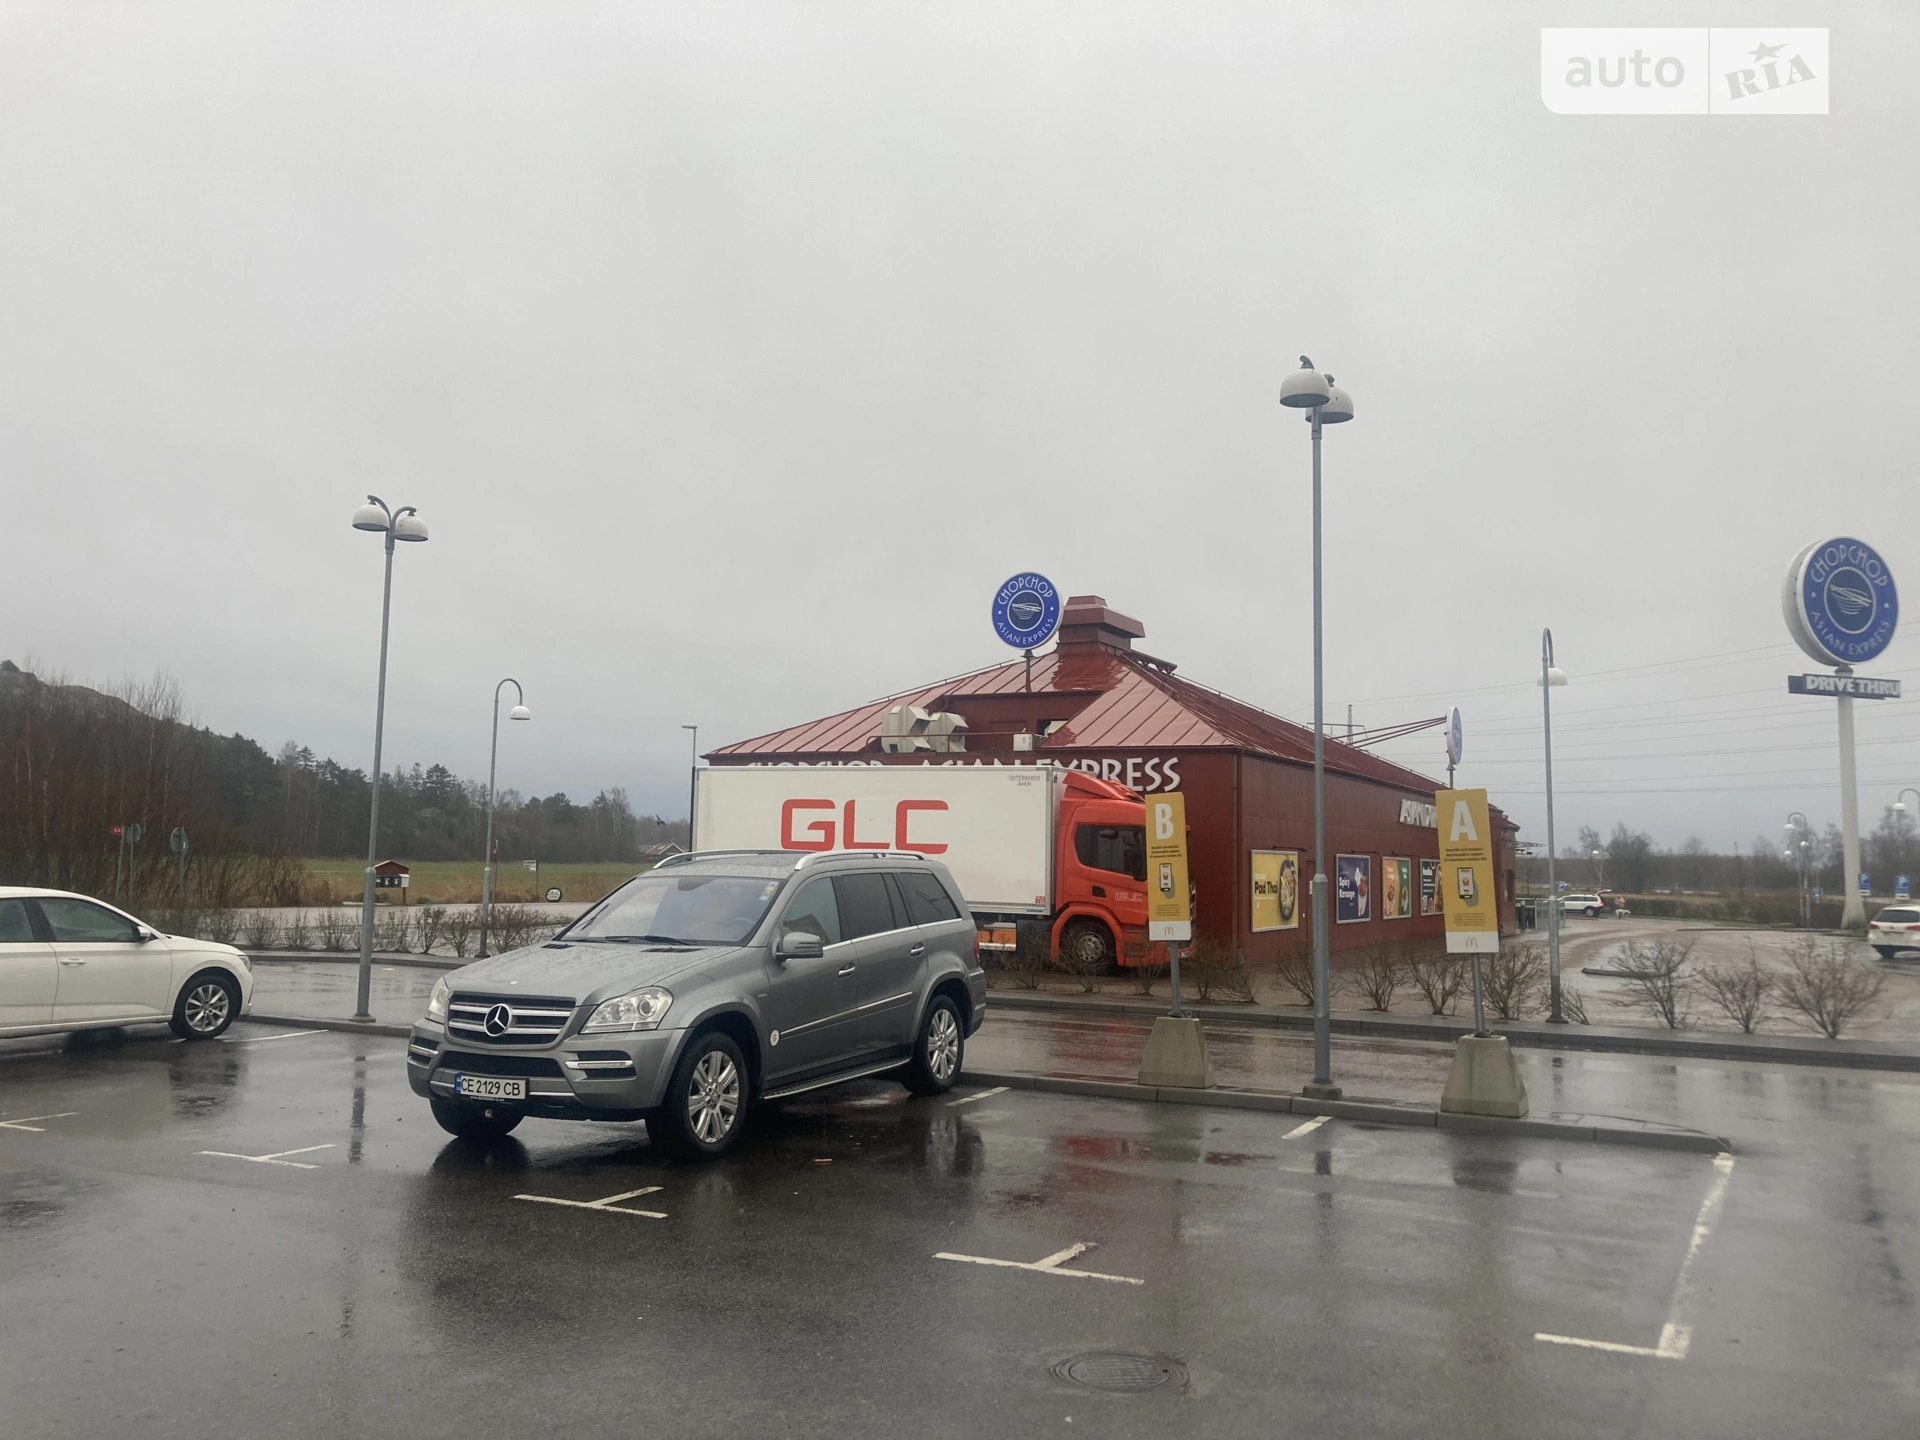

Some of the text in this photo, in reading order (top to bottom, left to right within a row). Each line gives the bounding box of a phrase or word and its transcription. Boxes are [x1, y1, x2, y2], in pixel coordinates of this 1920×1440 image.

[1810, 545, 1887, 586] CHOPCHOP
[998, 576, 1053, 605] CHOPCHOP
[997, 618, 1054, 645] ASIAN EXPRESS
[1811, 611, 1890, 655] ASIAN EXPRESS
[1805, 676, 1899, 695] DRIVE THRU
[1036, 757, 1181, 792] PRESS
[780, 799, 950, 855] GLC
[1155, 803, 1175, 840] B
[1450, 800, 1478, 842] A
[1115, 891, 1143, 902] GLC
[1254, 881, 1279, 894] Pad Thai
[1339, 876, 1350, 889] Spicy
[461, 1078, 521, 1096] CE 2129 CB
